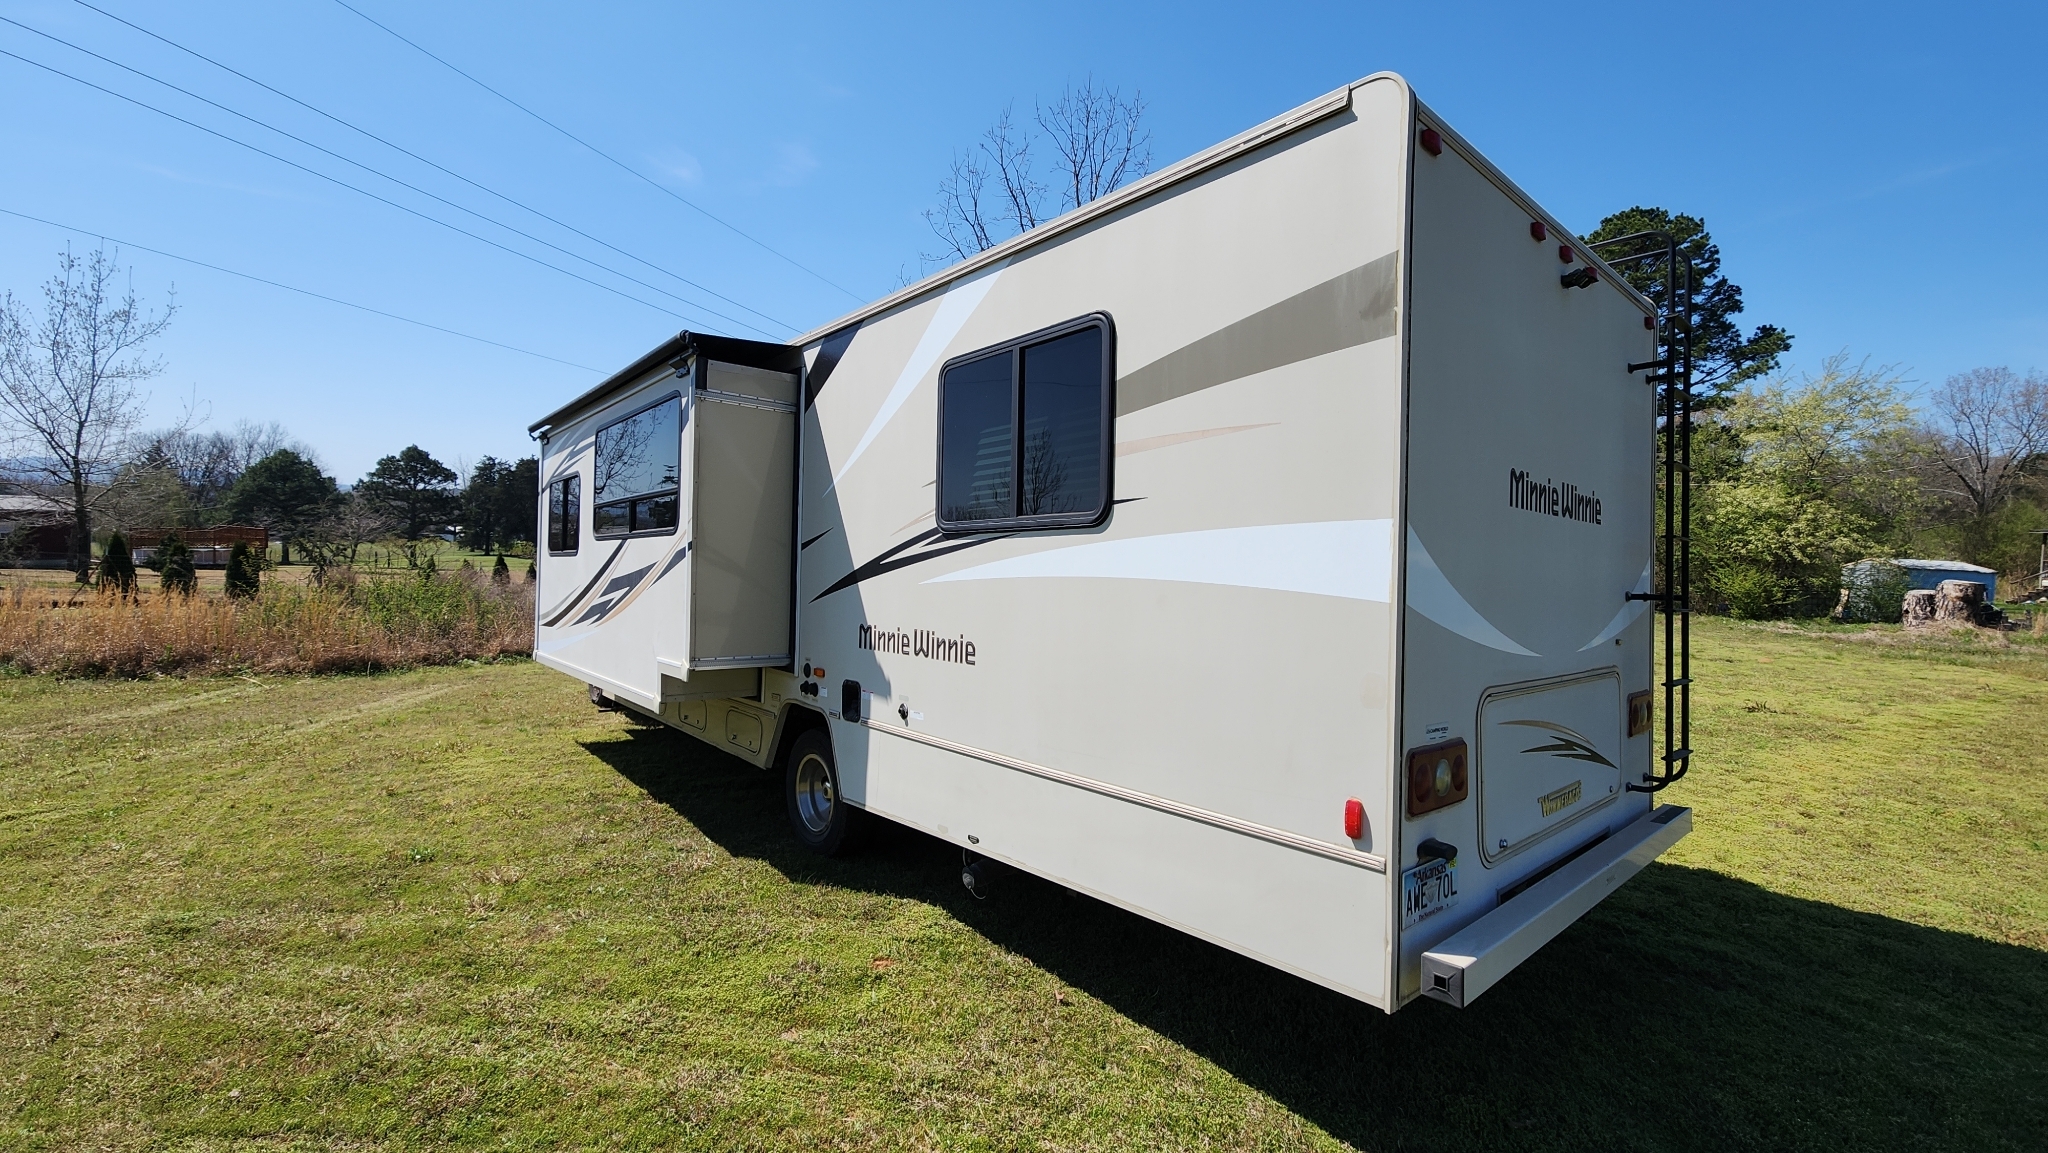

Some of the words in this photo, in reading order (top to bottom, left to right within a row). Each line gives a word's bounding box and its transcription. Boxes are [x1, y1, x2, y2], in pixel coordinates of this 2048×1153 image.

[1509, 467, 1559, 517] Minnie
[1561, 481, 1602, 526] Winnie
[858, 623, 910, 656] Minnie
[913, 628, 976, 666] Winnie
[1413, 862, 1447, 885] Arkansas
